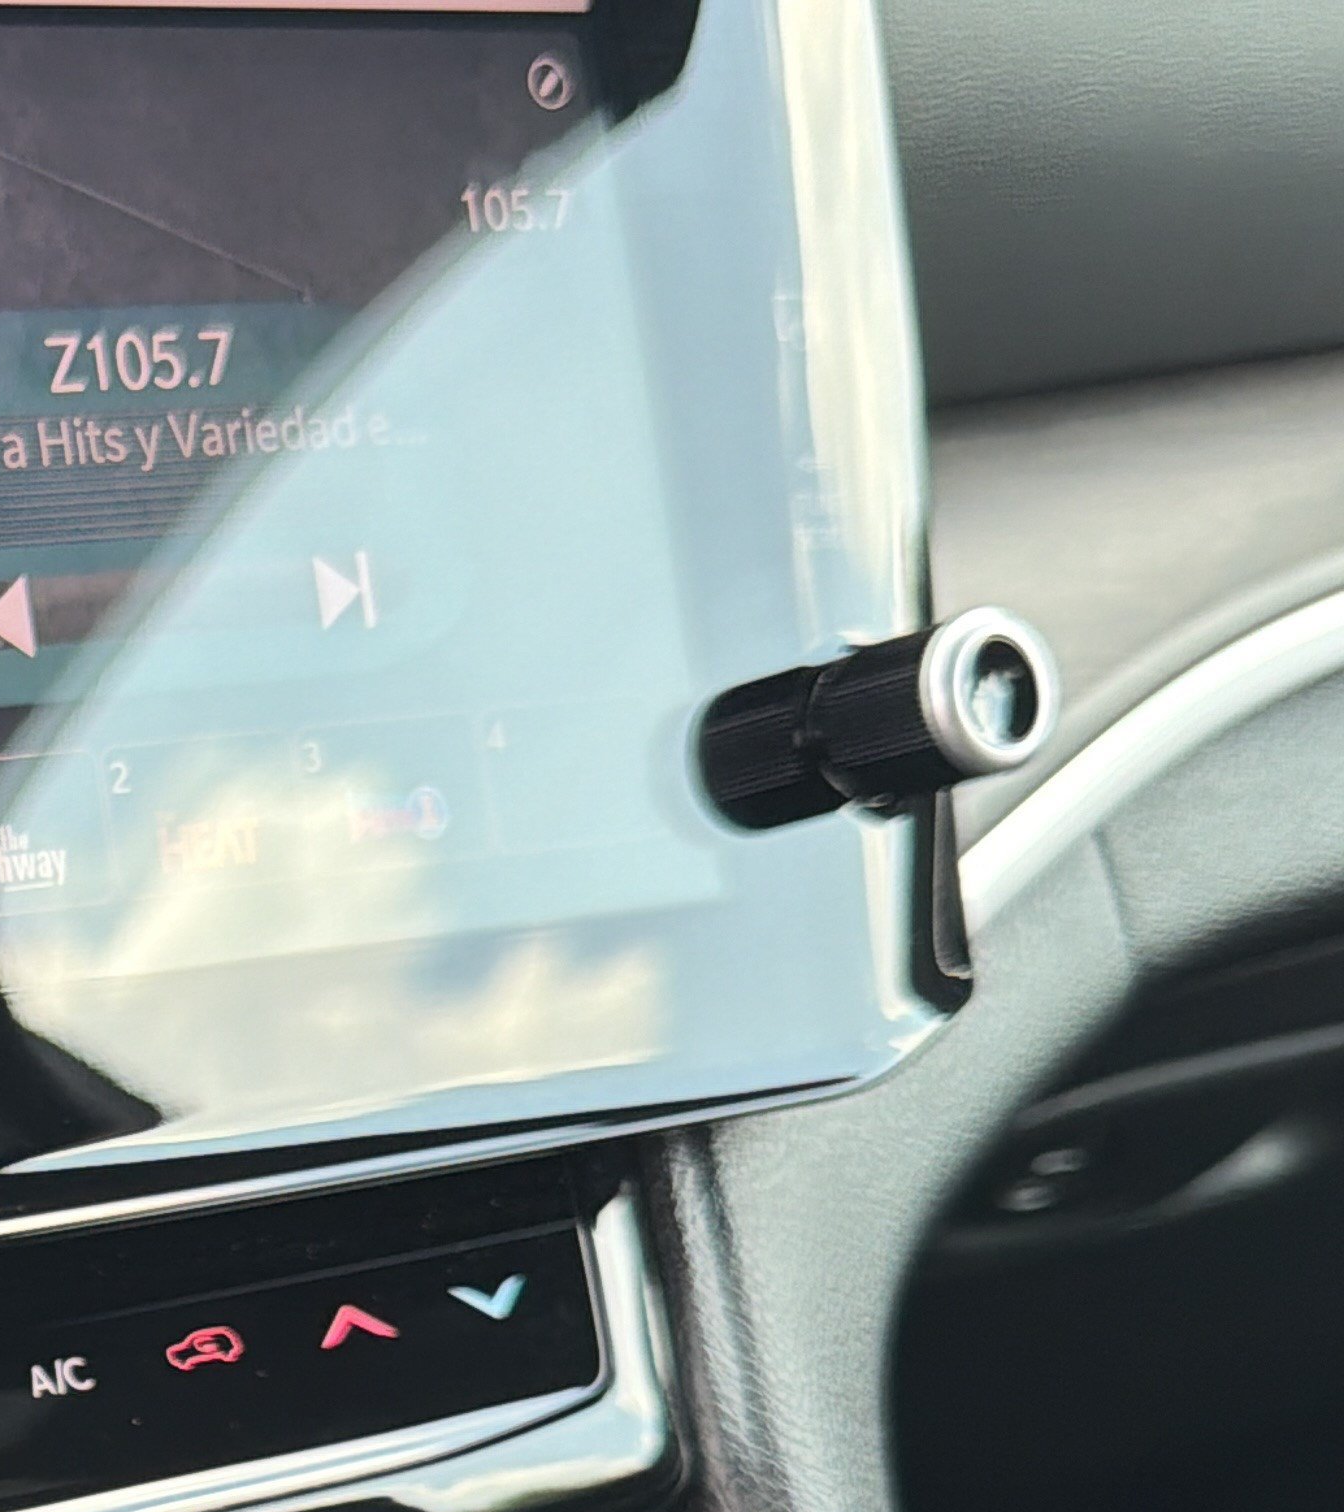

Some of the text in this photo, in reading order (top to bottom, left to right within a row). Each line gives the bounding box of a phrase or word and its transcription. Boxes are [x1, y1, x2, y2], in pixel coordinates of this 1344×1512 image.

[461, 188, 571, 232] 105.7
[43, 324, 234, 395] Z105.7
[37, 414, 125, 467] Hits
[134, 428, 160, 470] y
[165, 405, 357, 459] Variedad
[110, 760, 132, 795] 2
[301, 741, 323, 773] 3
[30, 1355, 96, 1398] A/C
